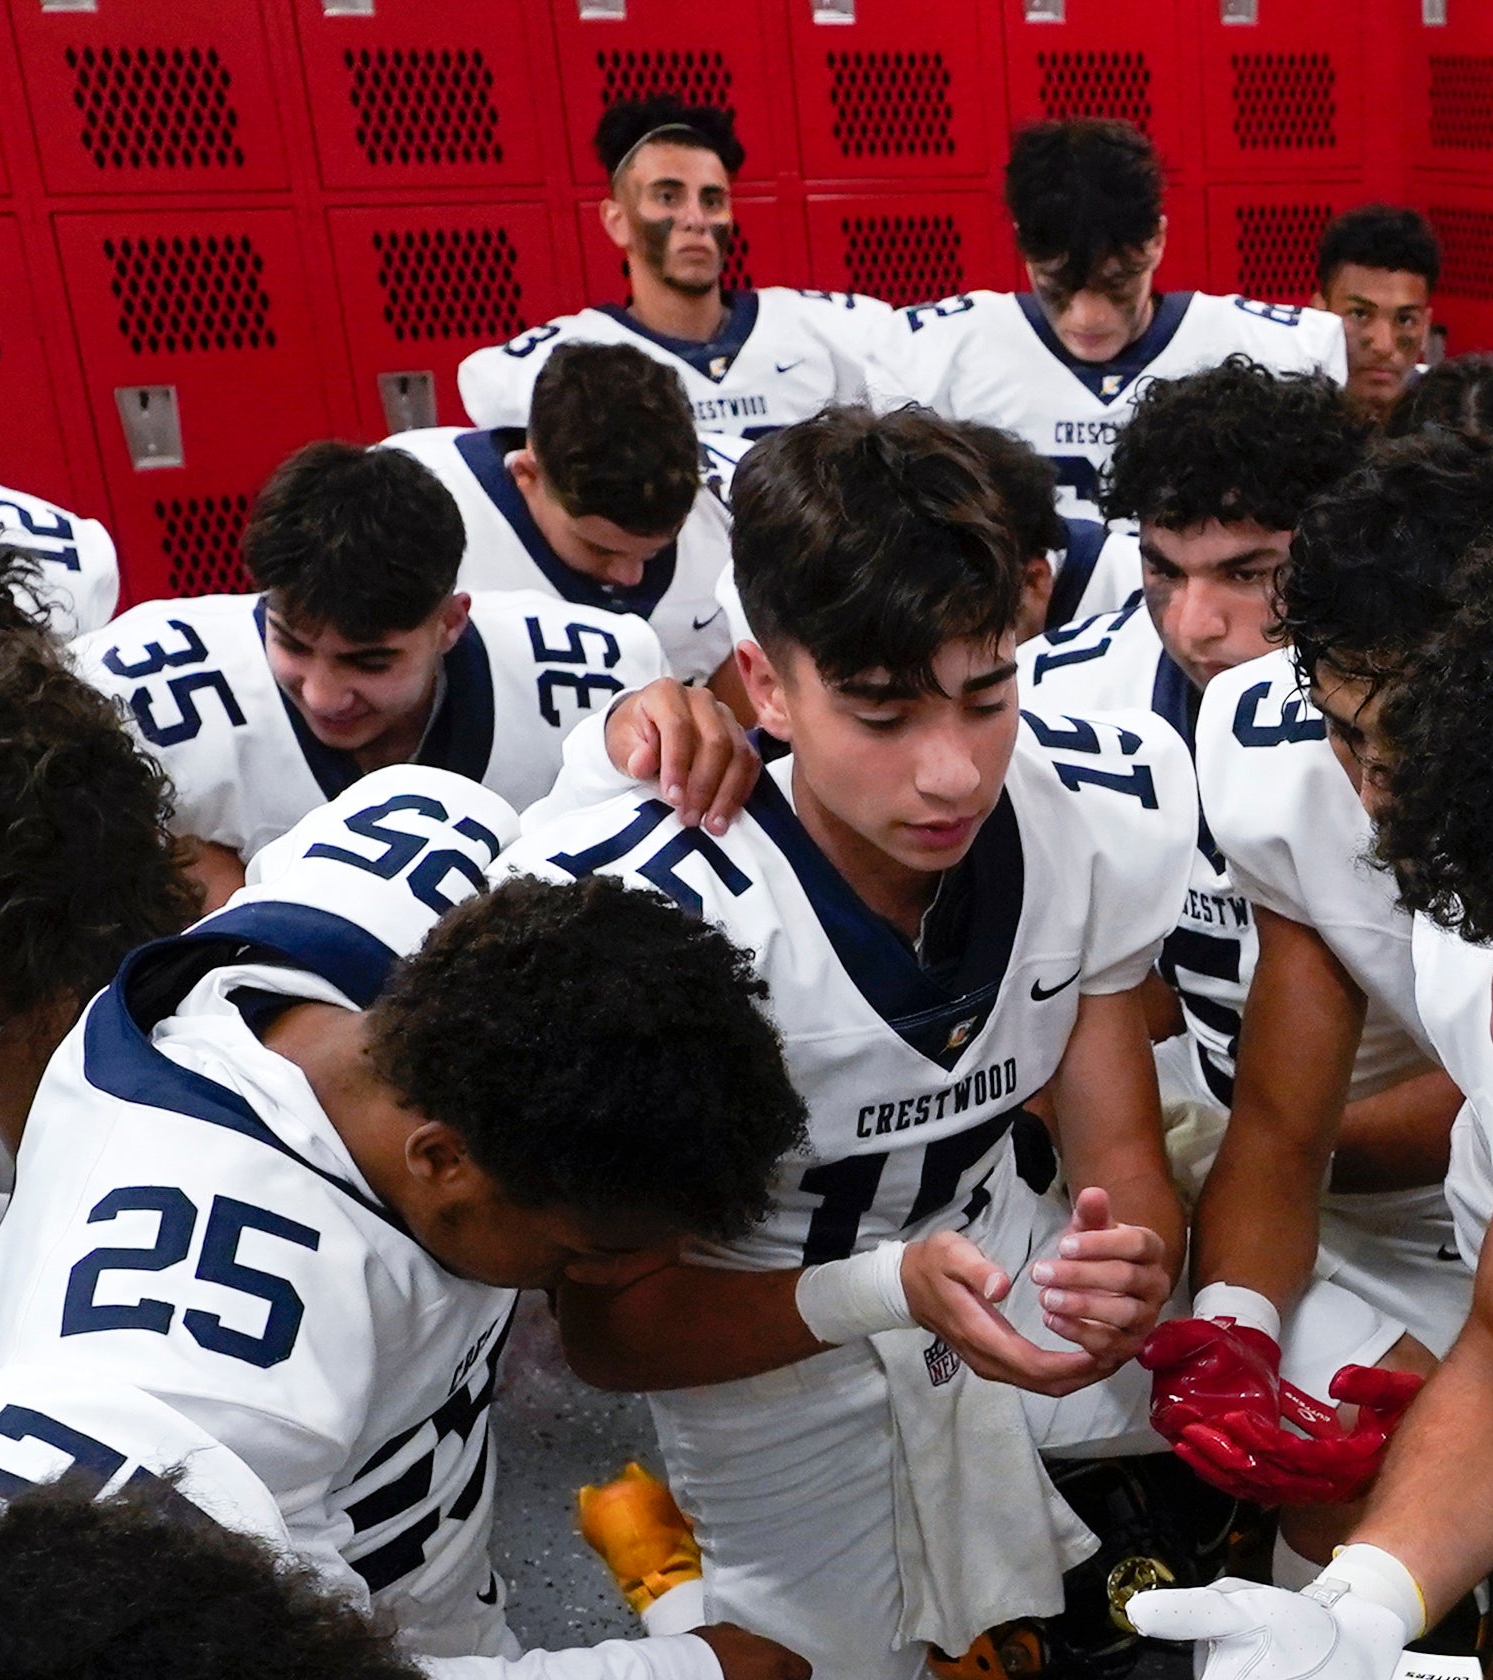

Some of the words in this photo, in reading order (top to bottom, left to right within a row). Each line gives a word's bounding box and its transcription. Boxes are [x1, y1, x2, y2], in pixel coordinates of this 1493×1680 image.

[108, 618, 247, 748] 35
[524, 615, 624, 729] 35
[1020, 708, 1160, 810] 15
[304, 794, 500, 915] 25
[856, 1057, 1018, 1139] CRESTWOOD
[59, 1186, 320, 1370] 25
